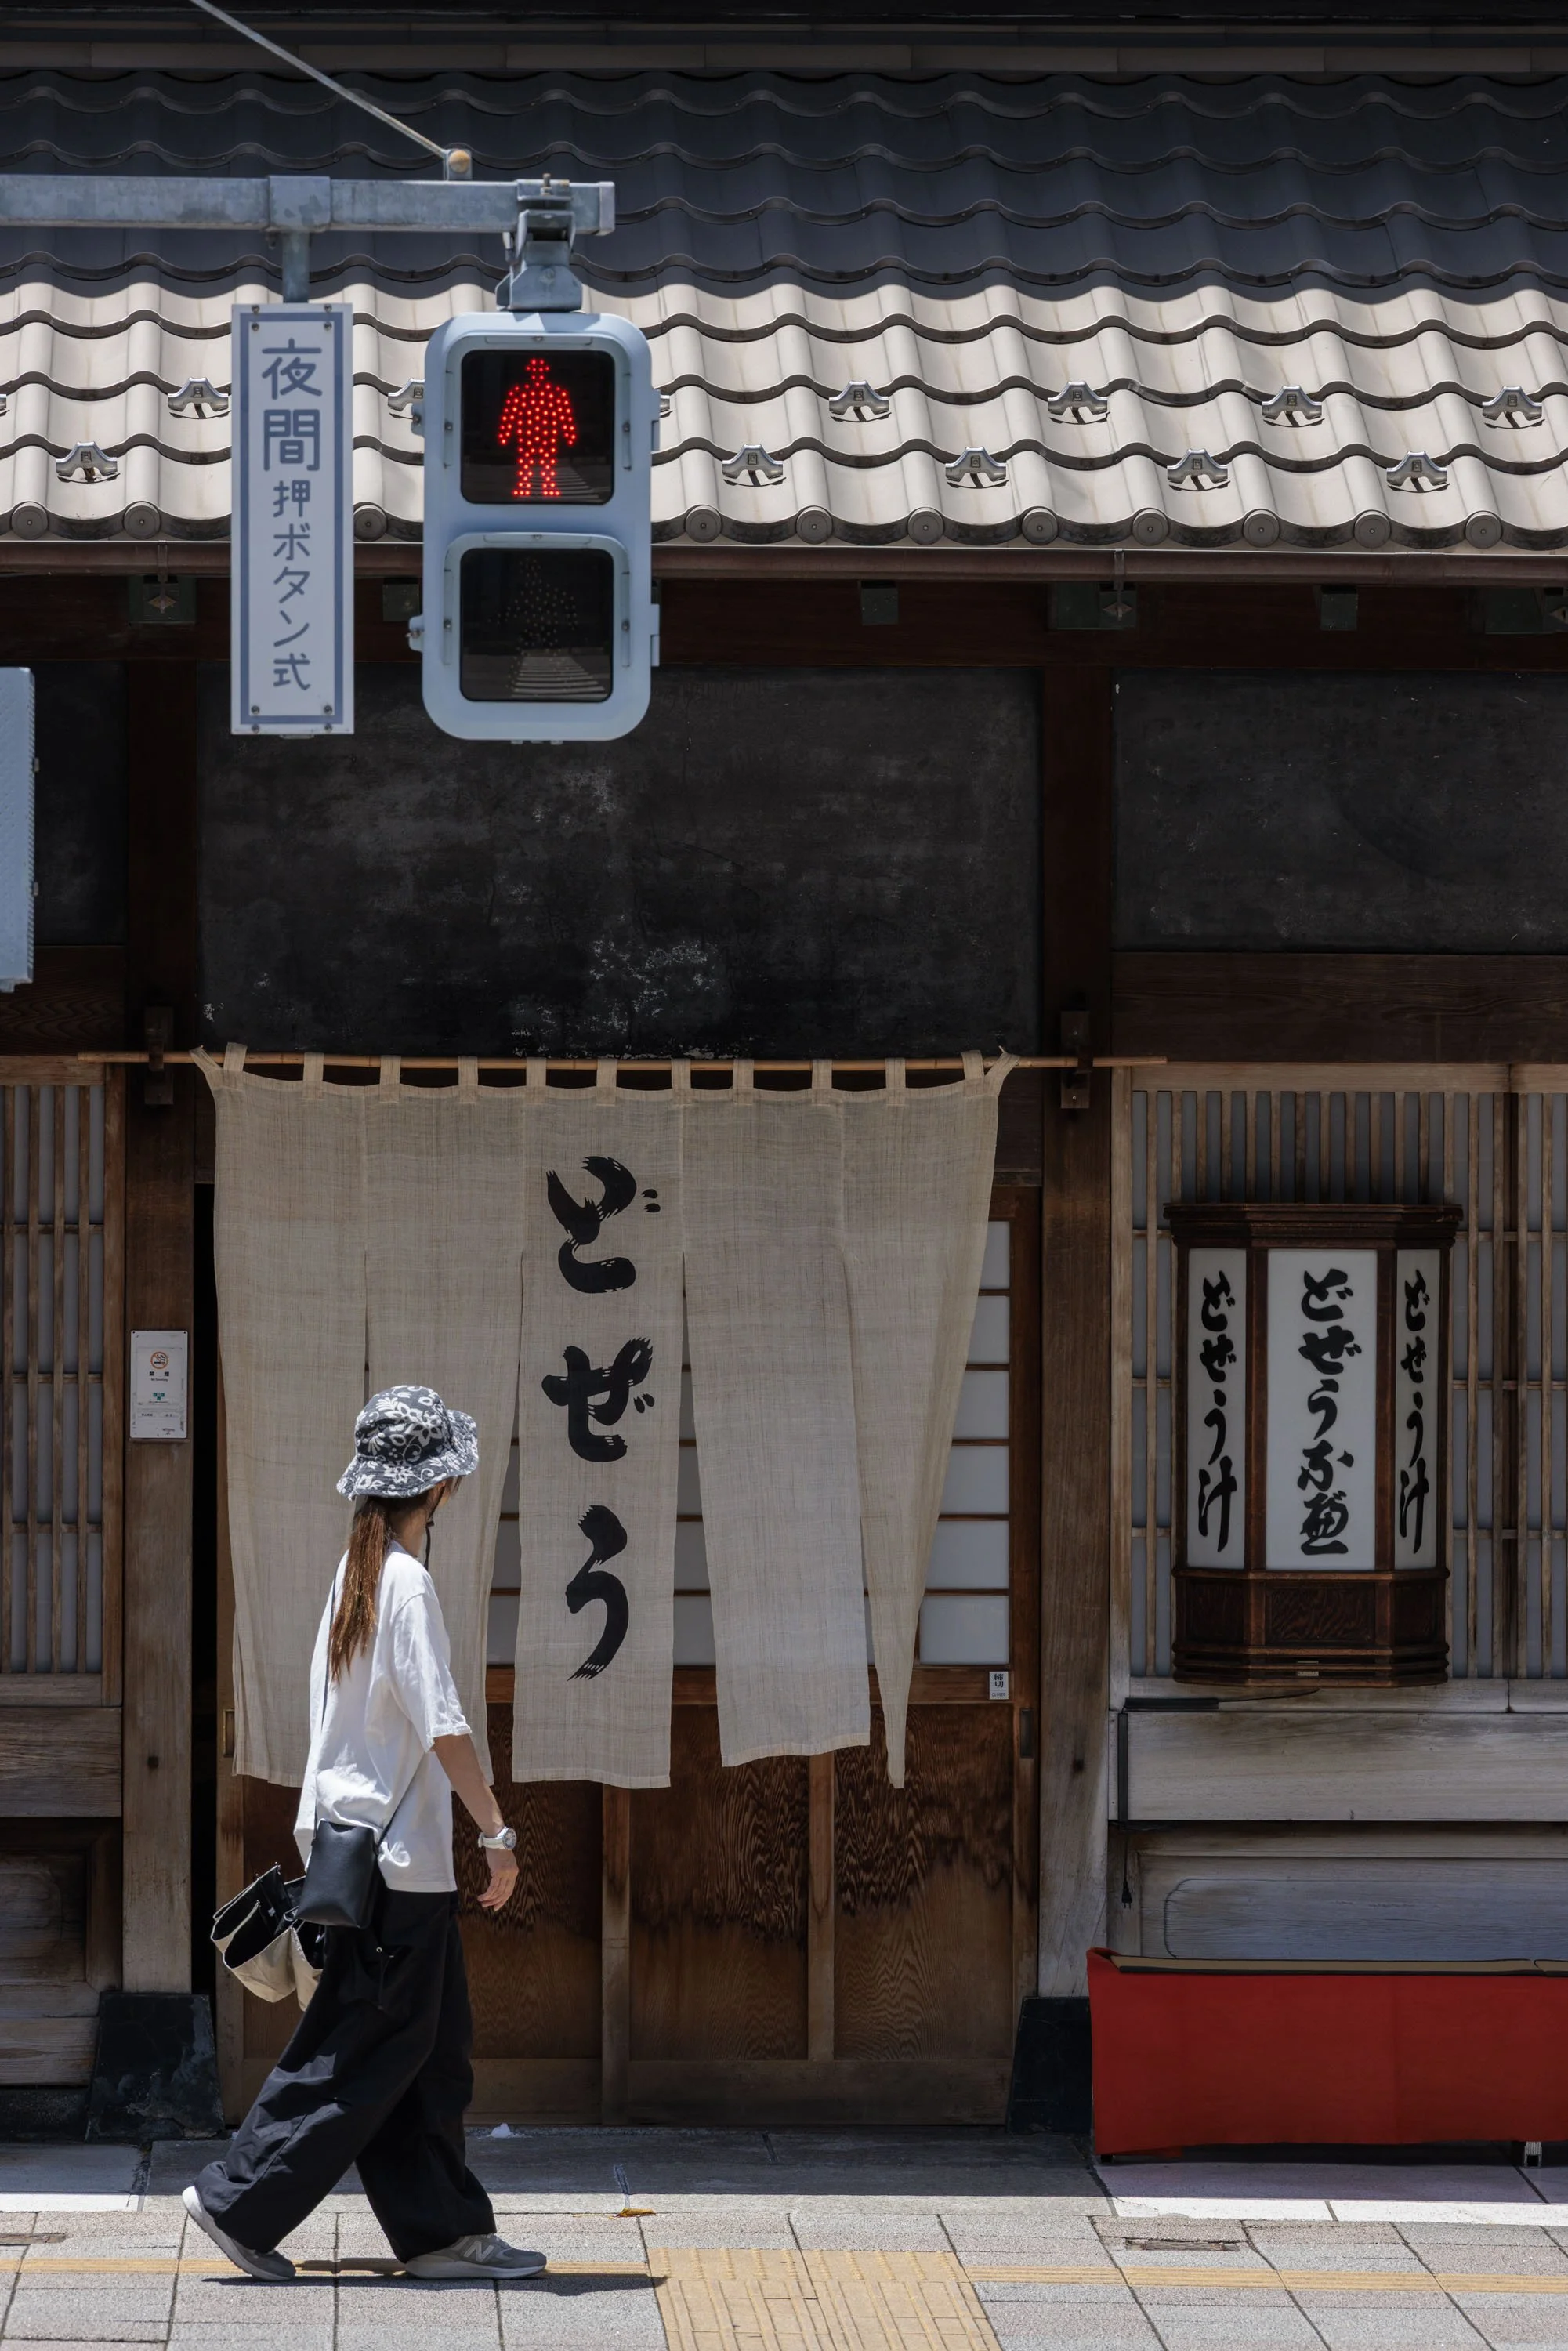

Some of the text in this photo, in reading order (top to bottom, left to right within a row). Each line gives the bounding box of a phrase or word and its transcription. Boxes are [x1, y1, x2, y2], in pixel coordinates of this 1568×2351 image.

[261, 338, 323, 691] 夜間押ボタン式
[542, 1156, 661, 1682] どぜう
[1198, 1270, 1238, 1553] どぜう汁
[1400, 1270, 1430, 1553] どぜう汁
[463, 2241, 494, 2262] N
